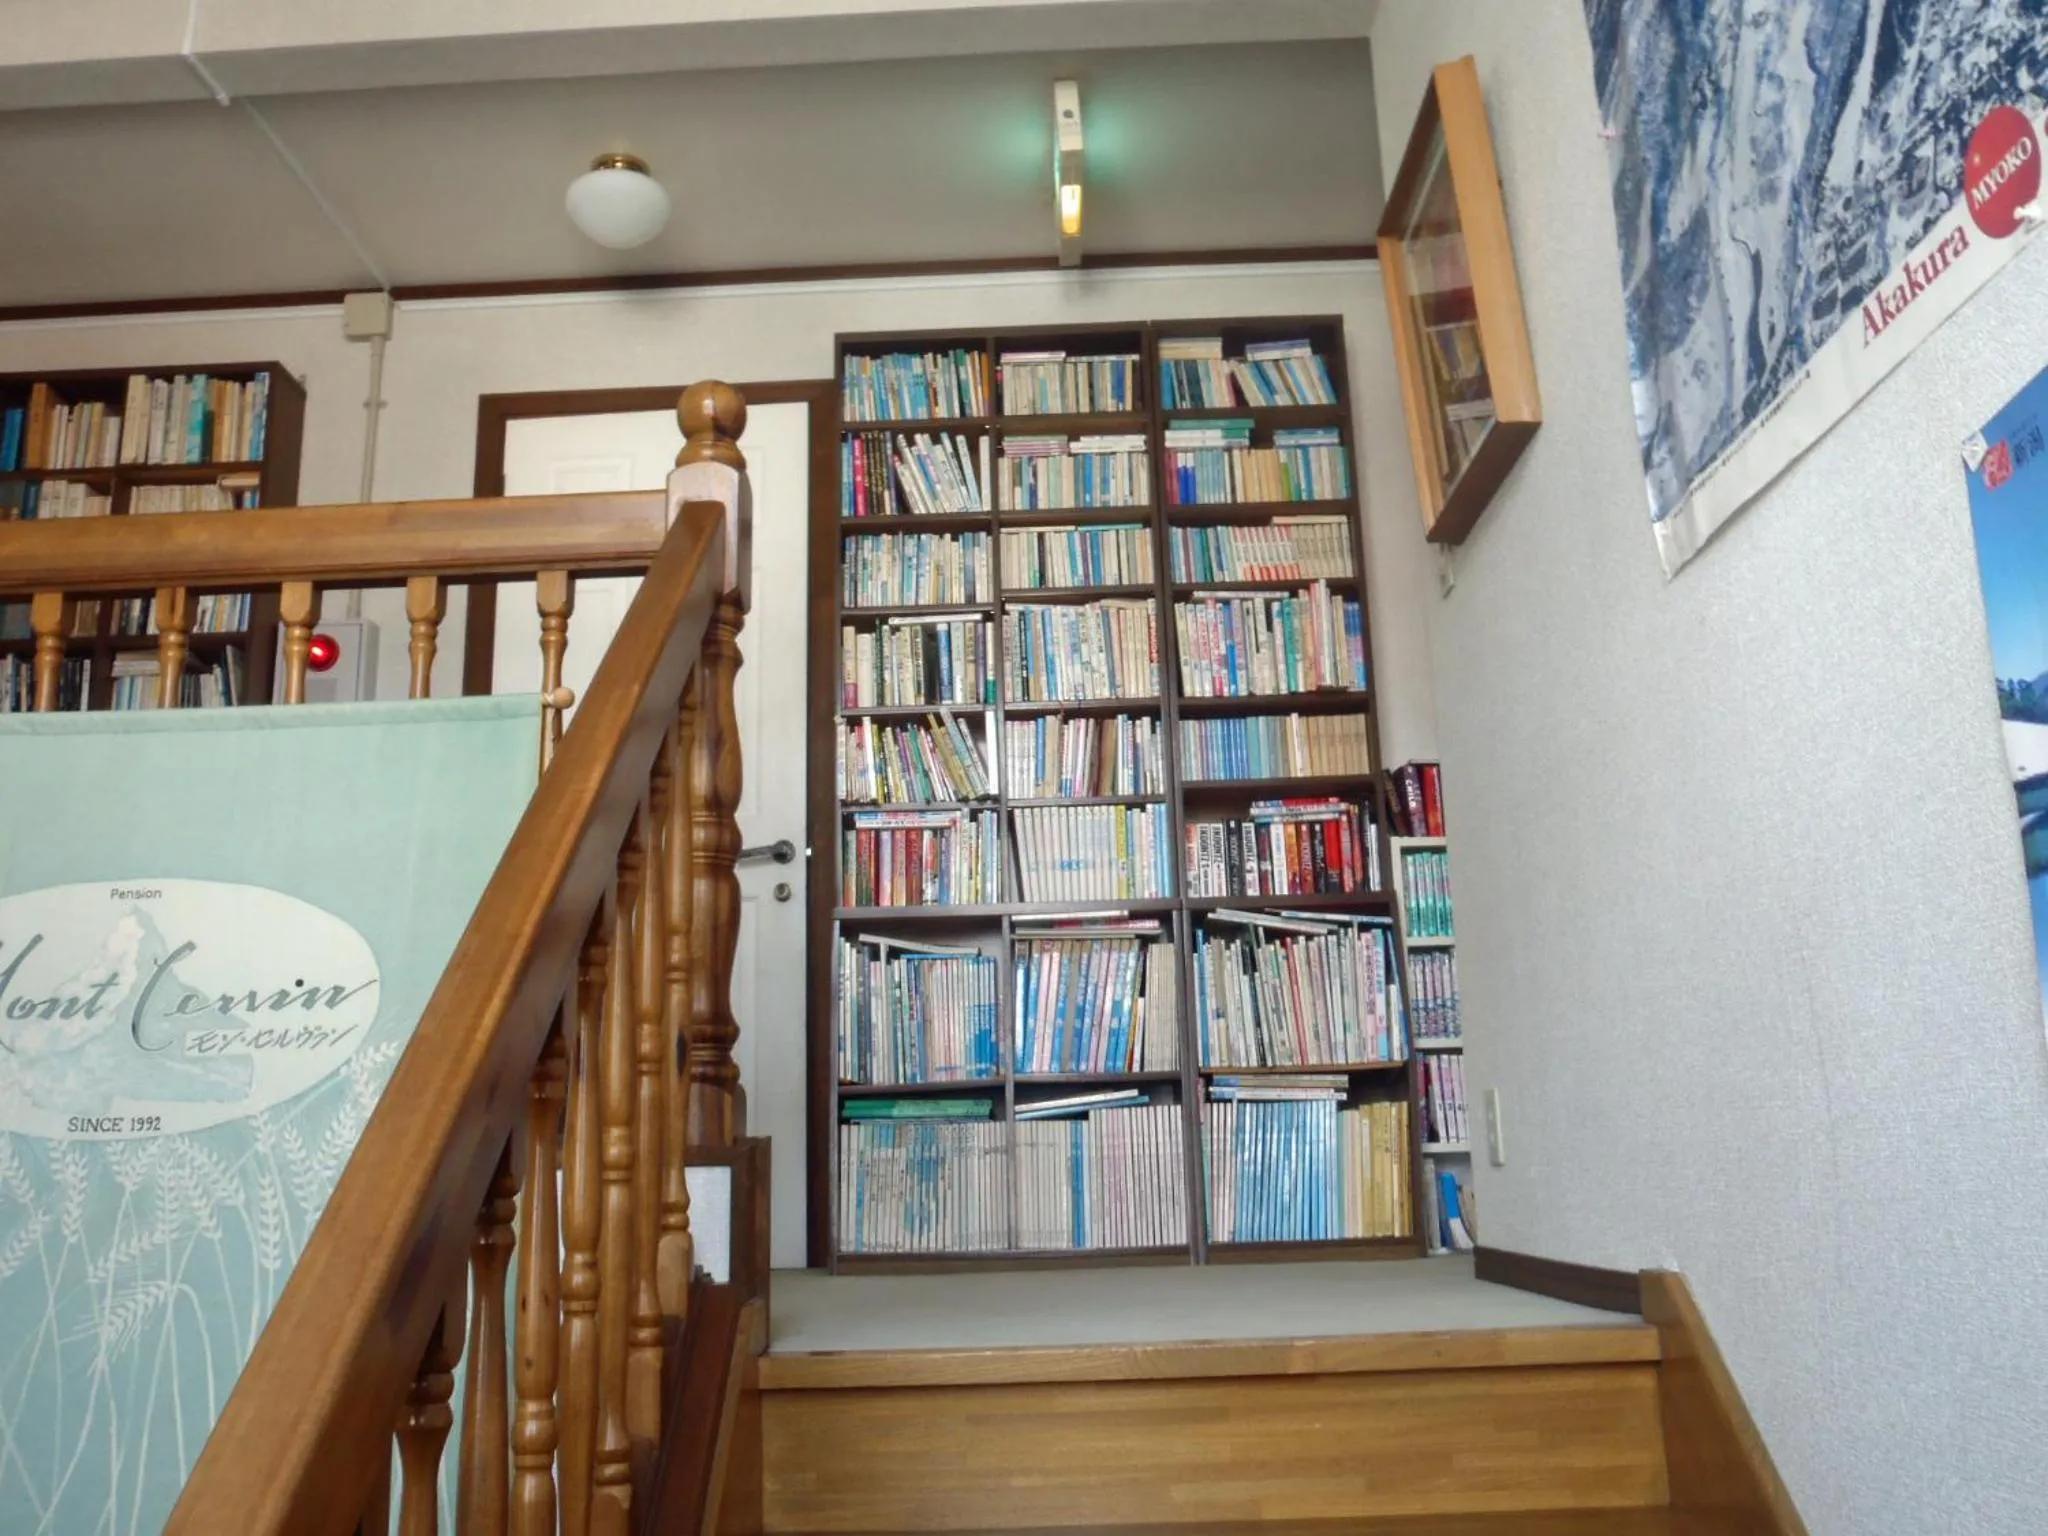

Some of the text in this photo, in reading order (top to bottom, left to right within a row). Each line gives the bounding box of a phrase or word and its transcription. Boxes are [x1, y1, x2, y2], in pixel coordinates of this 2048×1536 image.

[1969, 135, 2033, 210] MYOKO
[1861, 225, 1970, 349] Akakura
[110, 887, 162, 900] Pension
[67, 1116, 161, 1132] SINCE 1992
